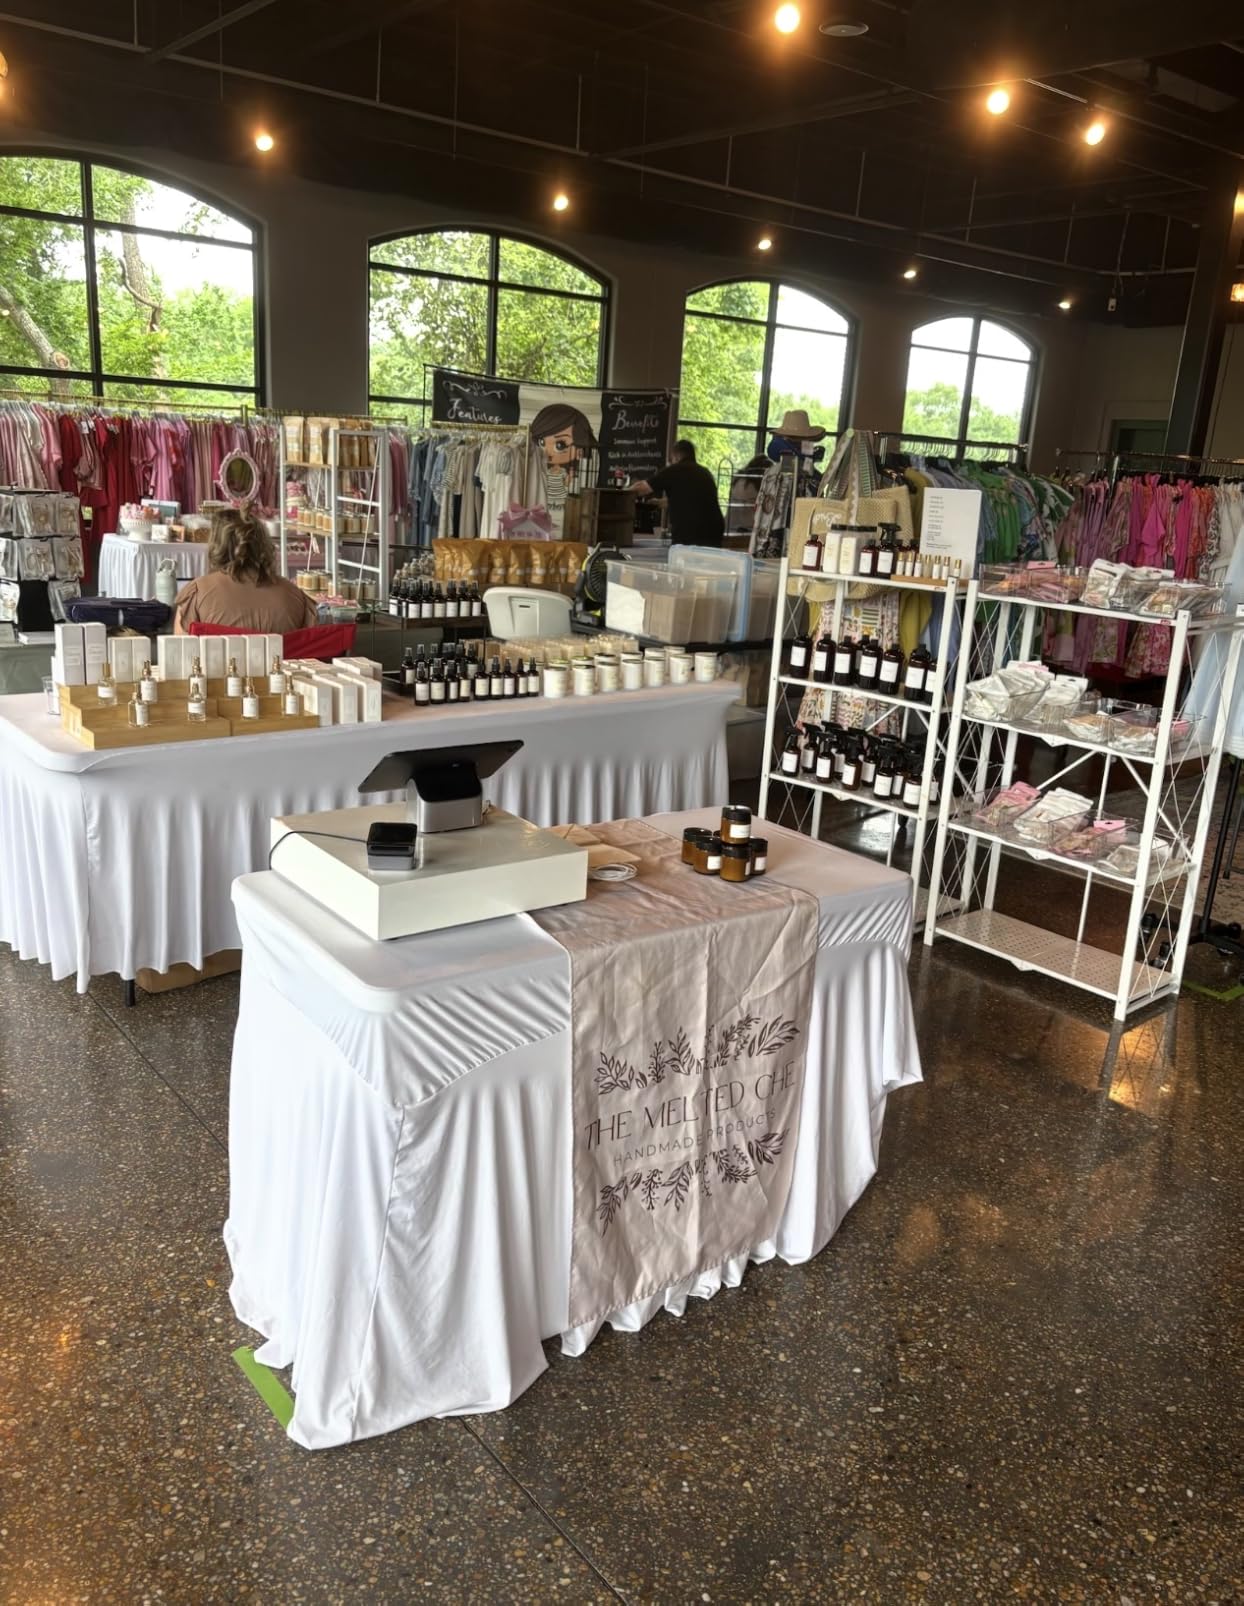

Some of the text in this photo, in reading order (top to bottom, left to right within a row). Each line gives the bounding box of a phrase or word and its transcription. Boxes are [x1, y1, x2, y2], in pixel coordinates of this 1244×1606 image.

[447, 398, 502, 424] Features
[584, 1110, 633, 1151] THE
[643, 1080, 745, 1129] MELTED
[613, 1108, 776, 1166] HANDMADE PRODUCTS
